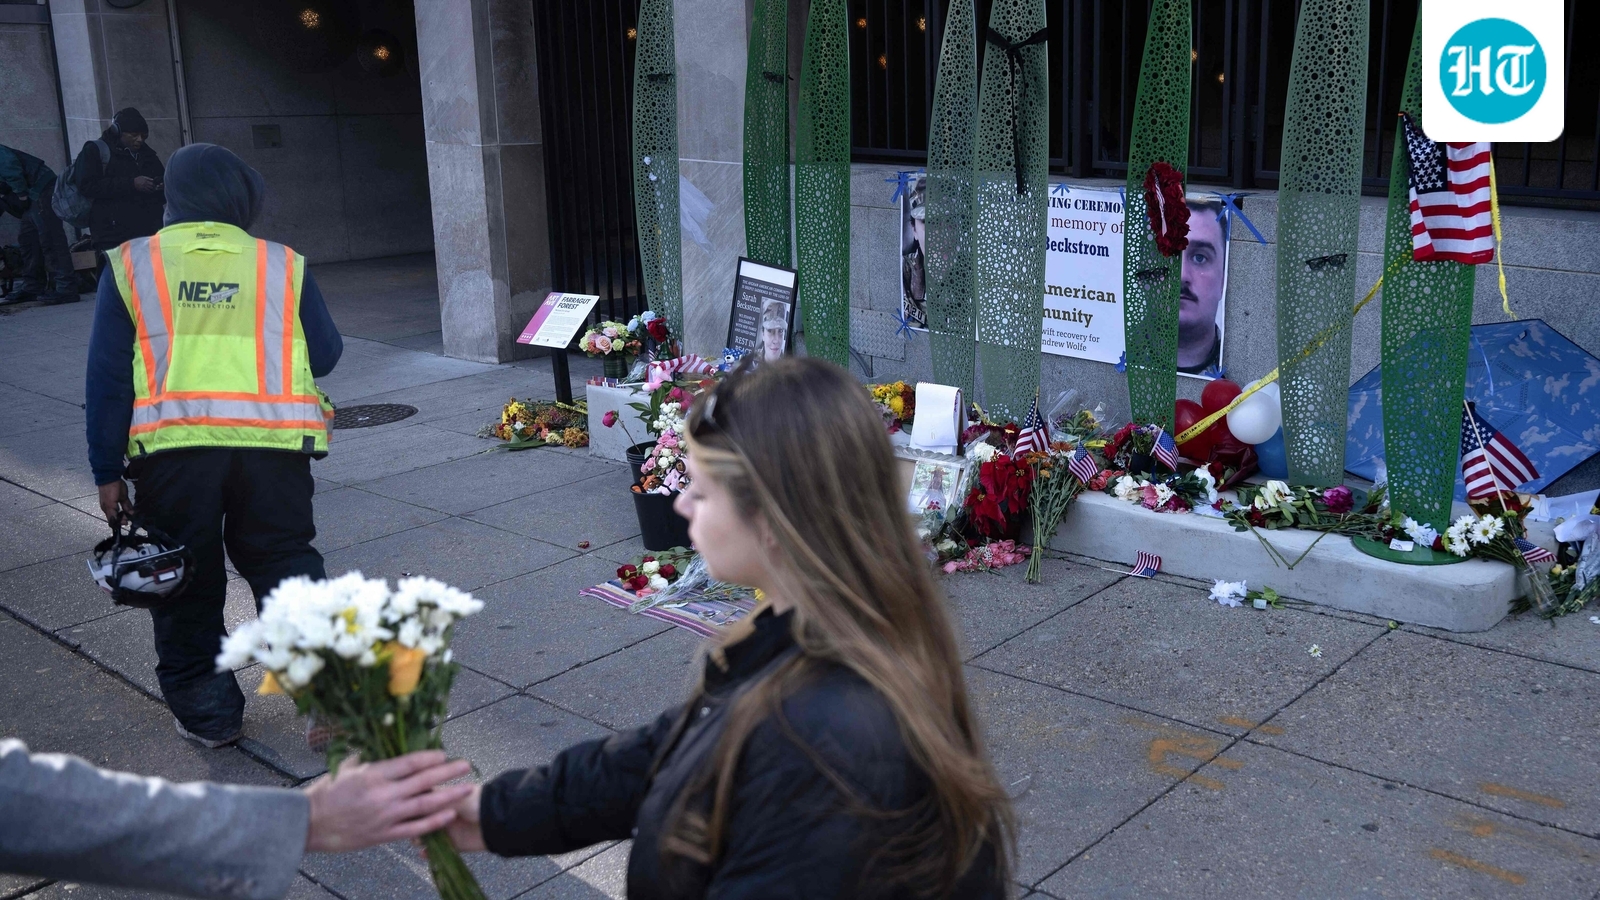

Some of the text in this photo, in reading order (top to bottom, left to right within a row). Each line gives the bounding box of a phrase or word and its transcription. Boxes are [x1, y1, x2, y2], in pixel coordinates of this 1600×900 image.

[1051, 217, 1124, 236] memory of
[178, 281, 239, 303] NEXT
[742, 292, 757, 303] Sarah
[1044, 284, 1116, 303] merican
[562, 296, 591, 304] FARRAGUT
[737, 300, 760, 313] Beckstrom
[735, 336, 755, 348] REST IN
[1056, 330, 1087, 343] recovery
[1089, 334, 1100, 343] for
[1066, 341, 1087, 351] Wolfe
